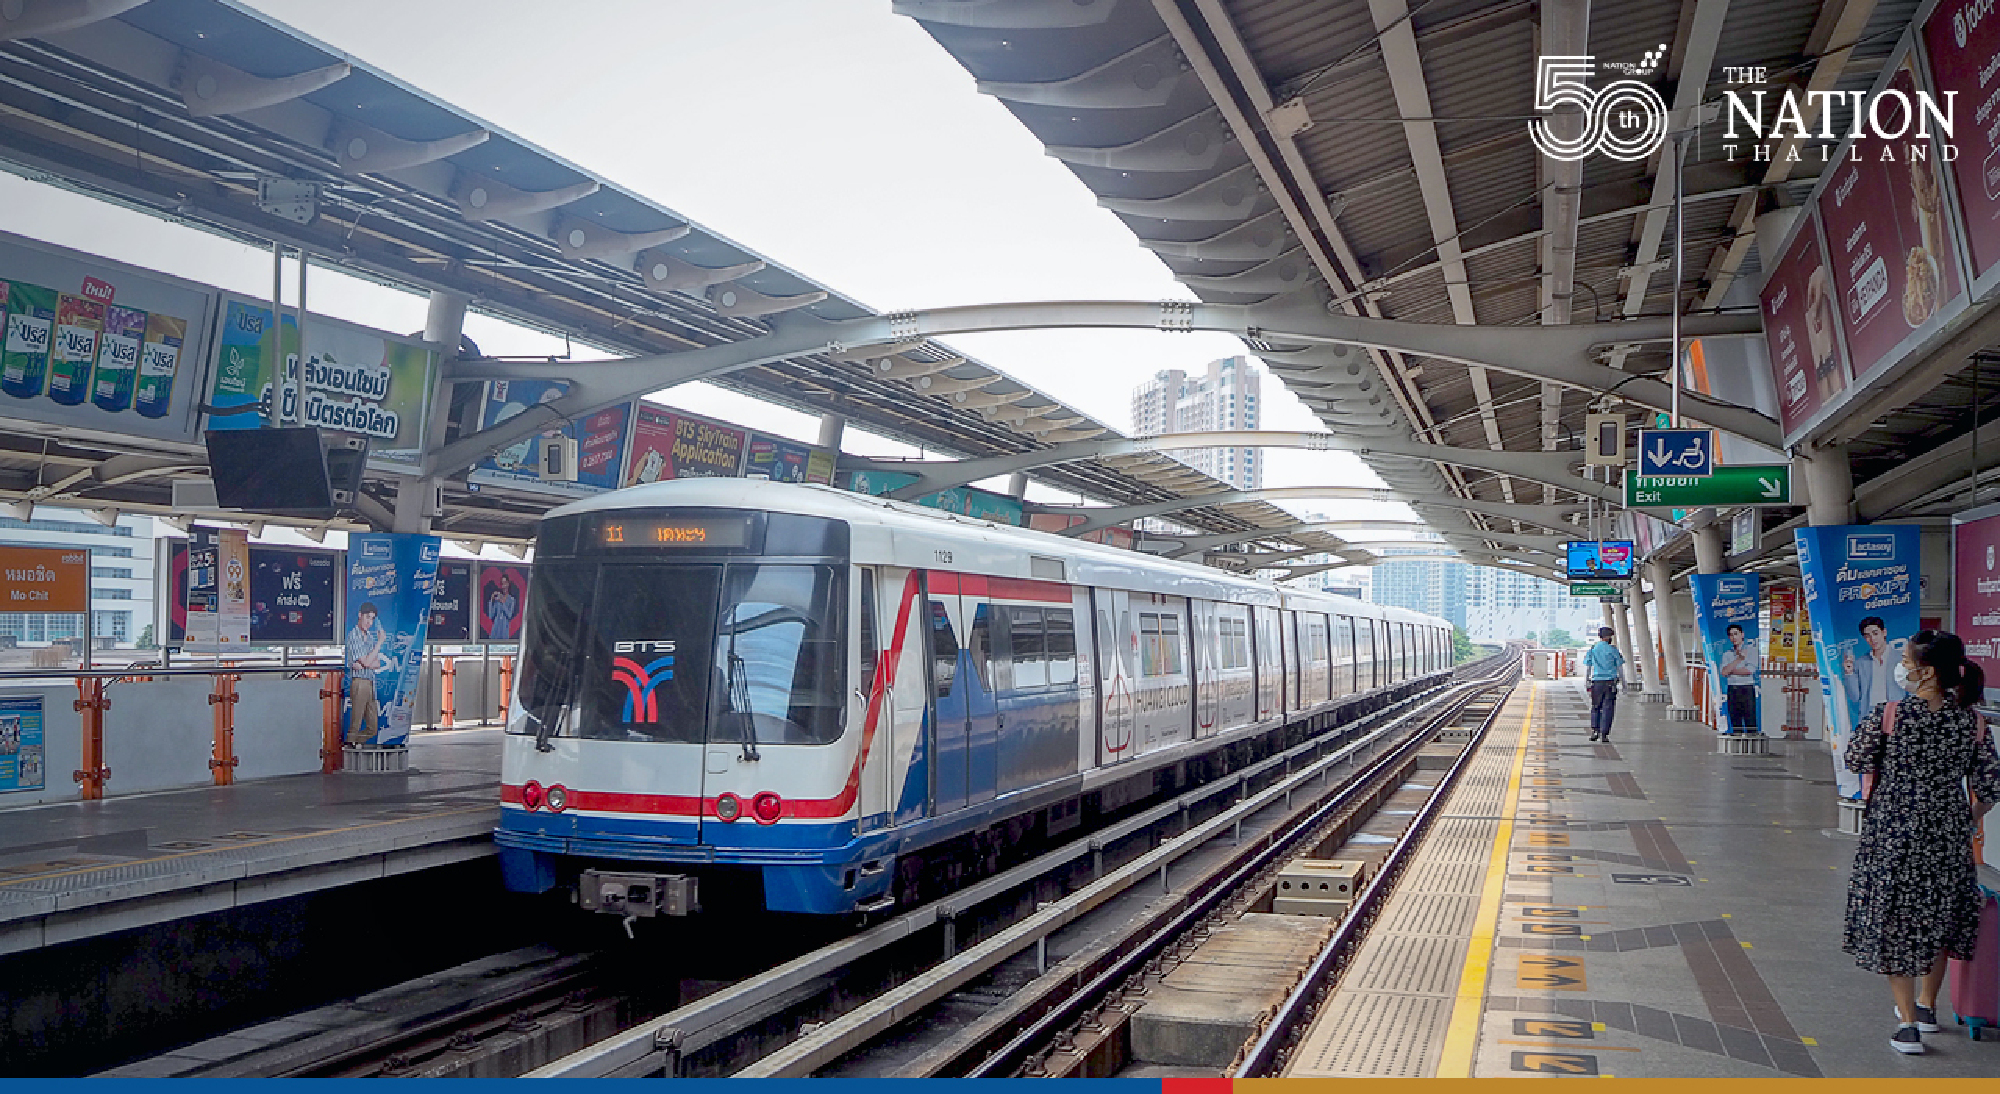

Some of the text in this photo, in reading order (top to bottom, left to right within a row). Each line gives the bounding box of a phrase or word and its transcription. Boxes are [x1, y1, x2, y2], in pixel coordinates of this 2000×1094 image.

[676, 419, 695, 439] BTS
[672, 438, 735, 469] Application
[1635, 491, 1662, 503] Exit
[606, 525, 623, 541] 11
[1850, 539, 1892, 556] Lactasoy
[5, 564, 56, 582] หมอชิต
[11, 589, 49, 600] Mo Chit
[613, 640, 675, 653] BTS
